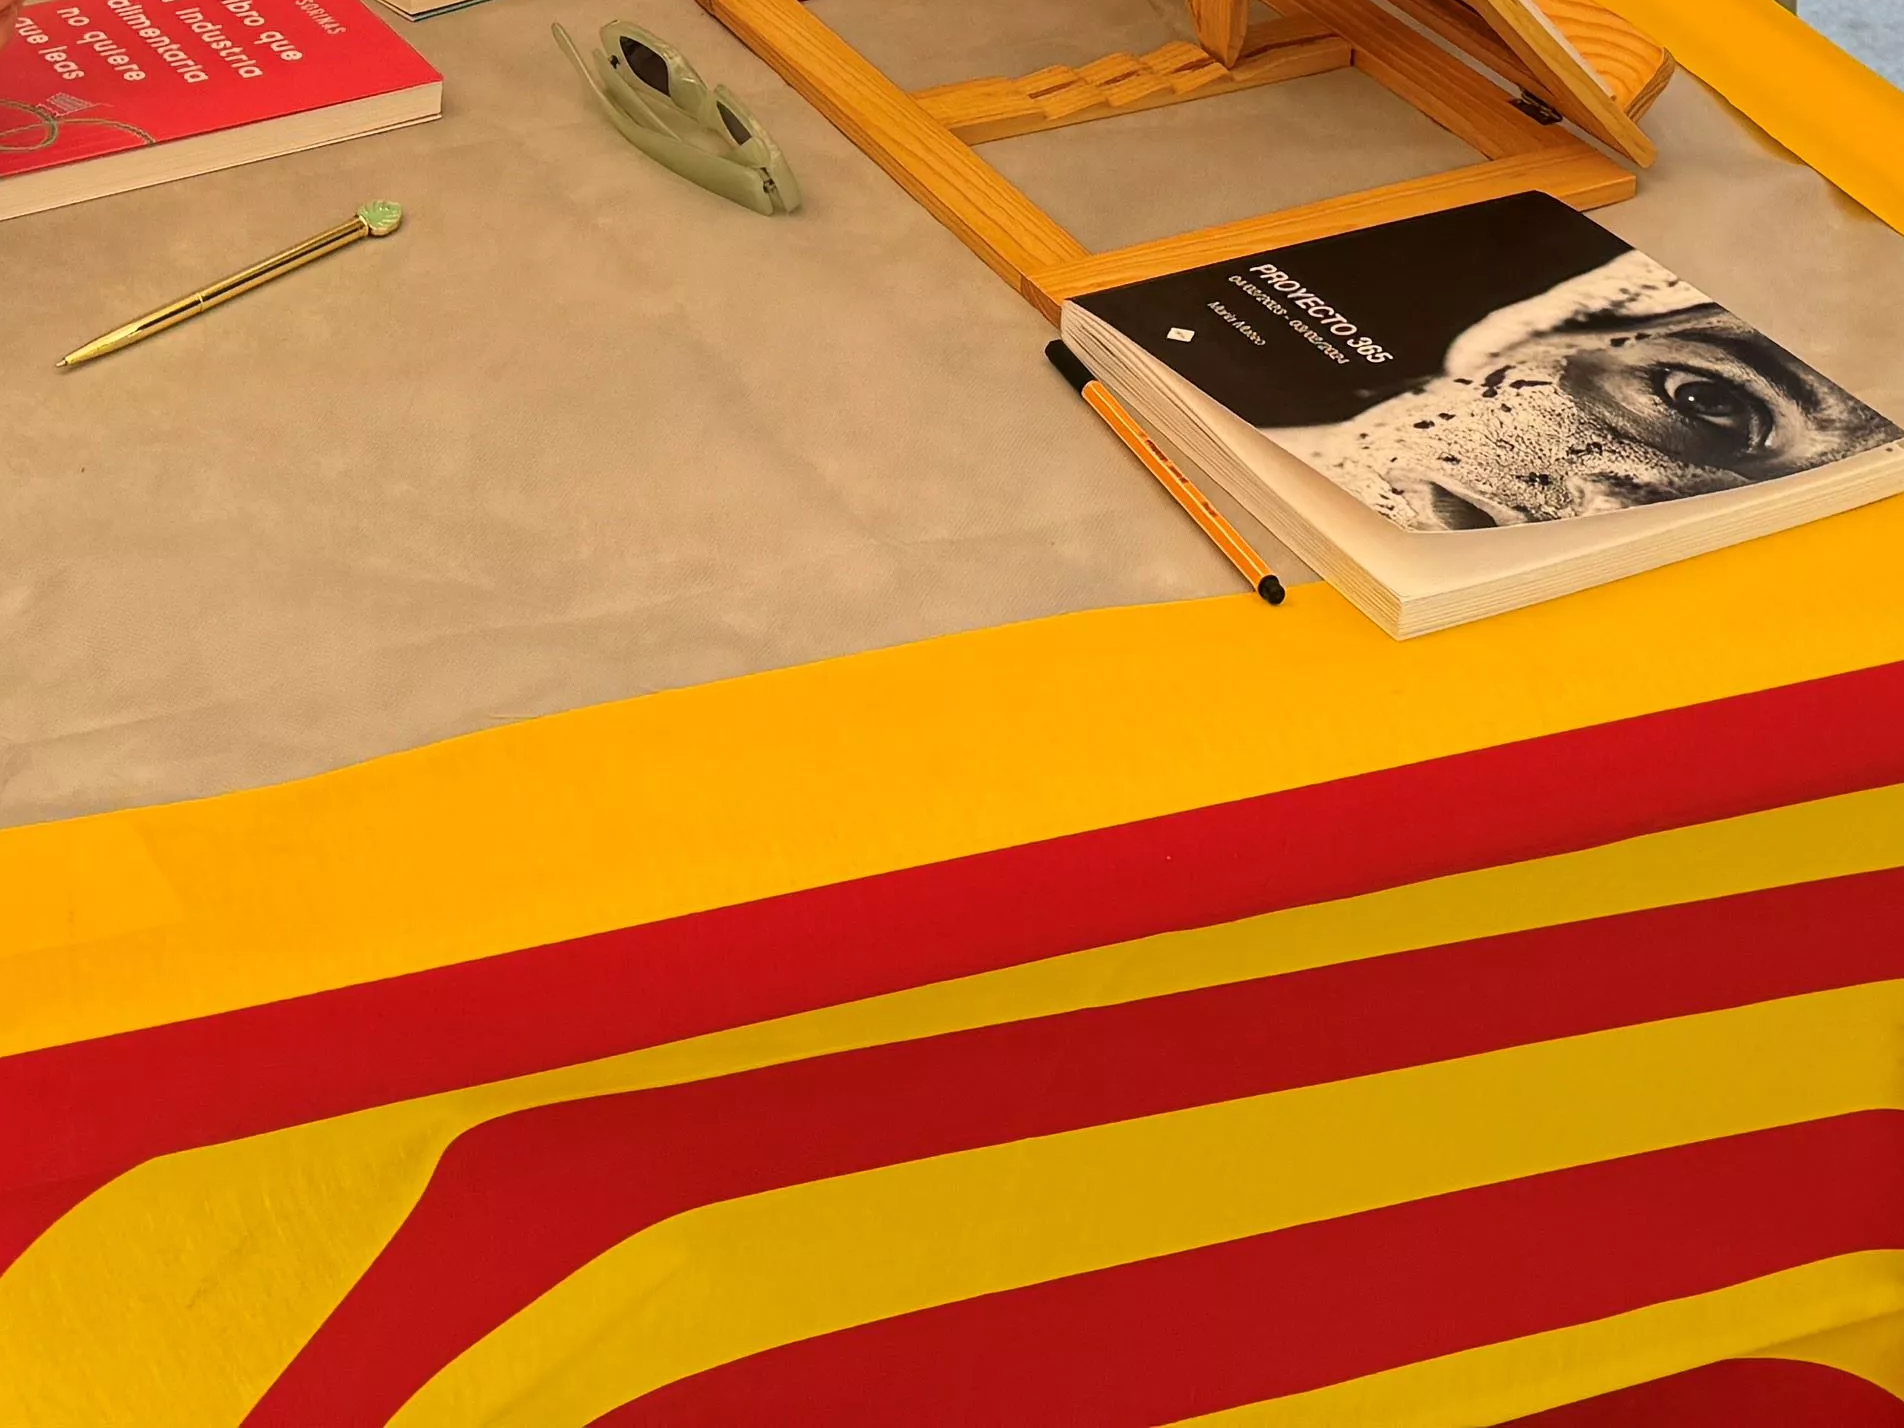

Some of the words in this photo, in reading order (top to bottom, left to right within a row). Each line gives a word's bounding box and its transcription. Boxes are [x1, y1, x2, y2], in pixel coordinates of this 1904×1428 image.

[15, 17, 49, 45] que
[38, 45, 85, 81] leas
[56, 7, 90, 28] no
[76, 29, 147, 83] quiere
[175, 7, 264, 80] industria
[258, 30, 304, 62] que
[1249, 263, 1358, 336] PROYECTO
[1346, 337, 1393, 363] 365
